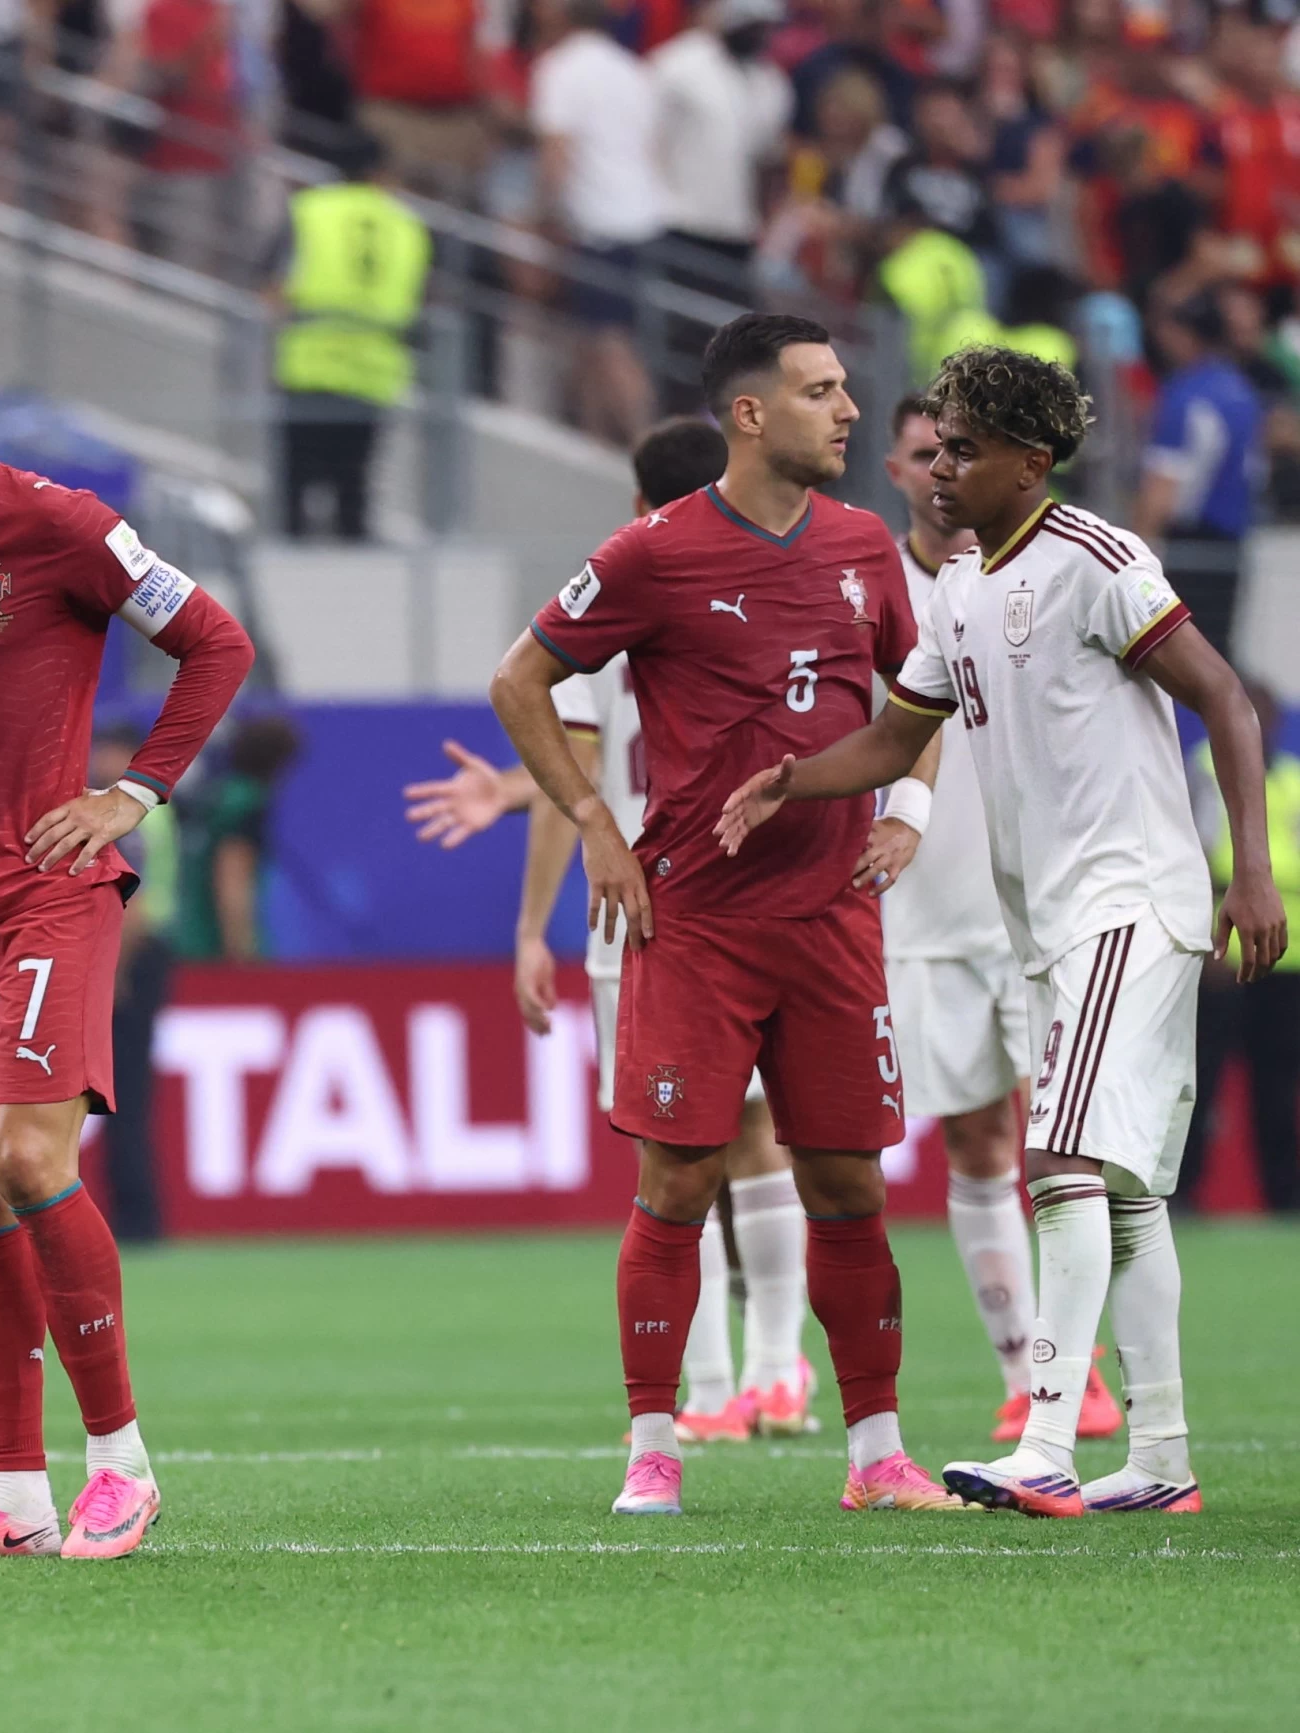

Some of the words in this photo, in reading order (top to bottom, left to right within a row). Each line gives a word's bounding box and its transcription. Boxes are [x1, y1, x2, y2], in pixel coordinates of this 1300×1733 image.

[134, 567, 171, 608] UNITES
[145, 601, 162, 617] the
[158, 576, 182, 603] World
[786, 648, 818, 712] 5
[952, 655, 989, 730] 19
[17, 957, 54, 1040] 7
[872, 1004, 900, 1084] 5
[150, 1002, 598, 1196] TALI
